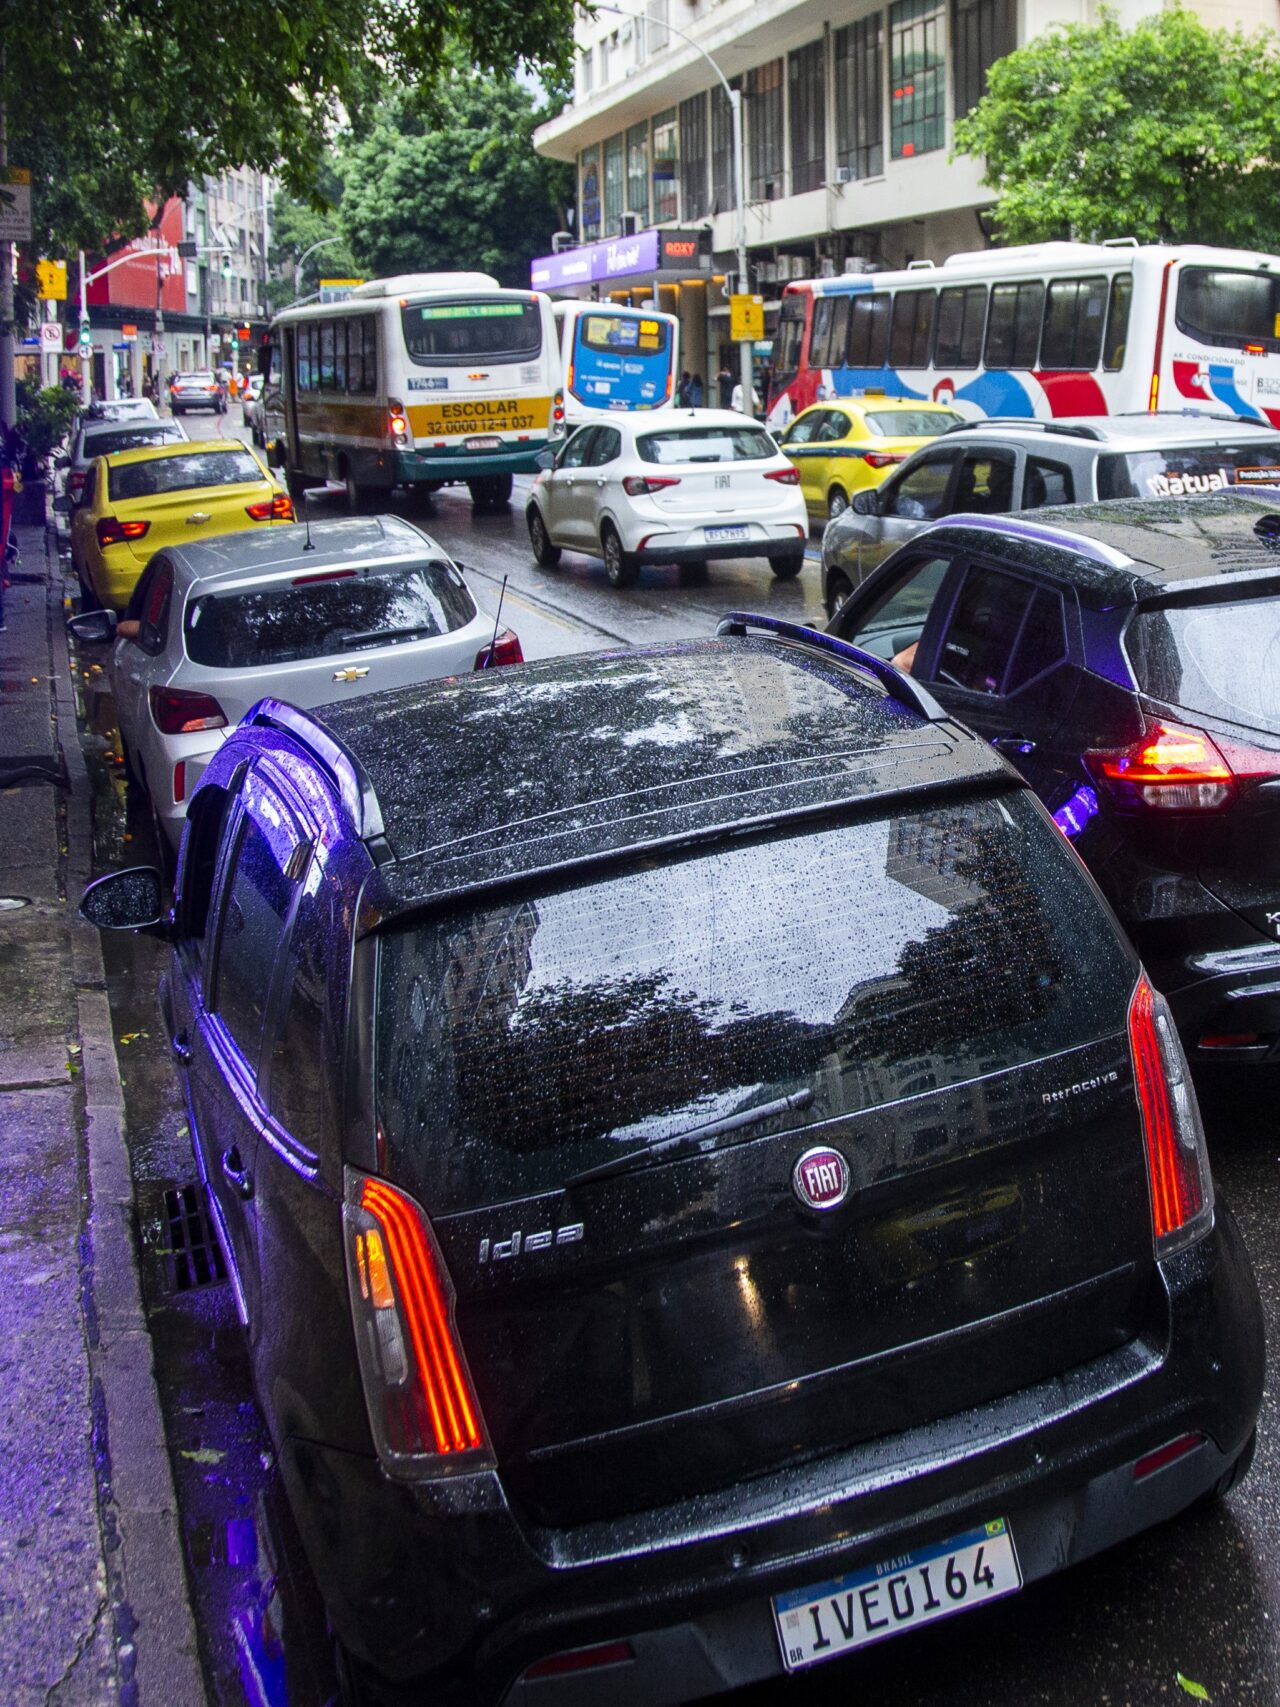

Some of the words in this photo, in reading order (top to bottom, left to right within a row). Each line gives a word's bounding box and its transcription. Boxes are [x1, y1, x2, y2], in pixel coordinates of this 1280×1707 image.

[665, 242, 695, 256] ROXY
[1187, 353, 1245, 366] CONDICIONADO
[442, 401, 518, 418] ESCOLAR
[512, 415, 534, 428] 037
[715, 475, 731, 488] FIAT
[806, 1161, 839, 1197] FIAT
[876, 1553, 914, 1576] BRASIL
[790, 1647, 803, 1663] BR
